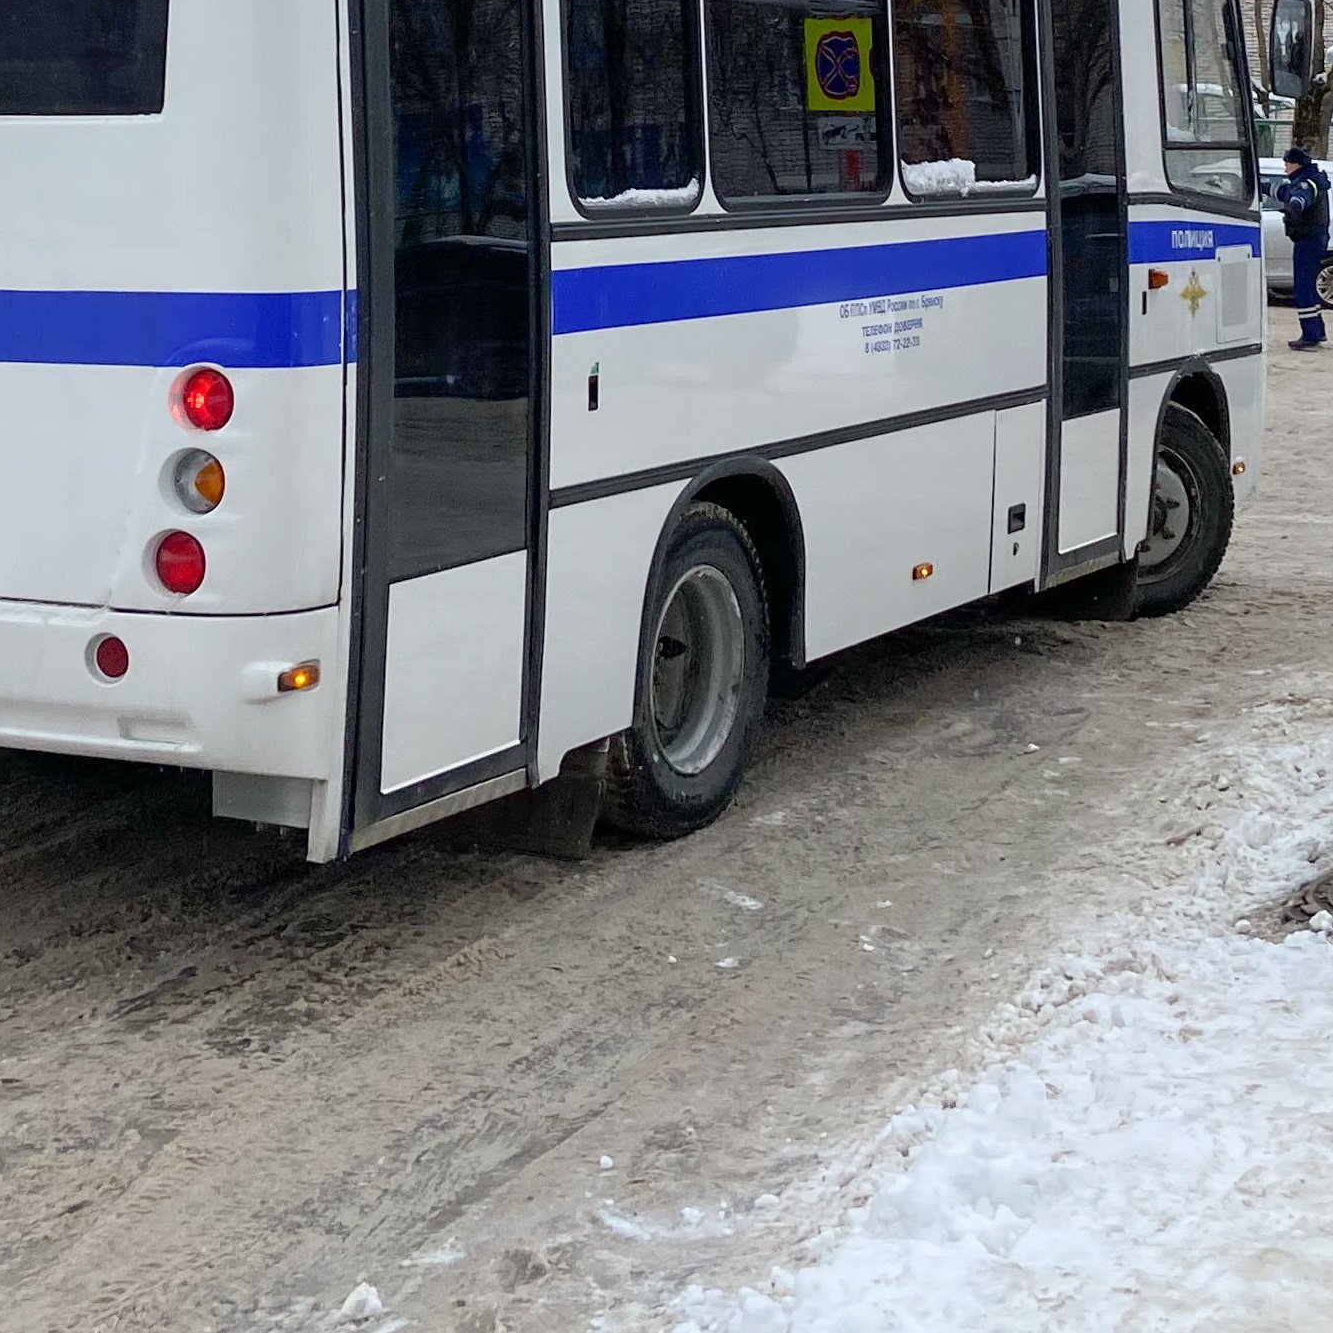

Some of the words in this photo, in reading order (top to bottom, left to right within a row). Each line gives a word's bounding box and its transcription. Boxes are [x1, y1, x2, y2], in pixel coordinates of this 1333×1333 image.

[1171, 230, 1214, 252] ПОЛИЦИЯ
[862, 323, 893, 337] ТЕЛЕФОН
[894, 318, 923, 335] ДОВЕРИЯ
